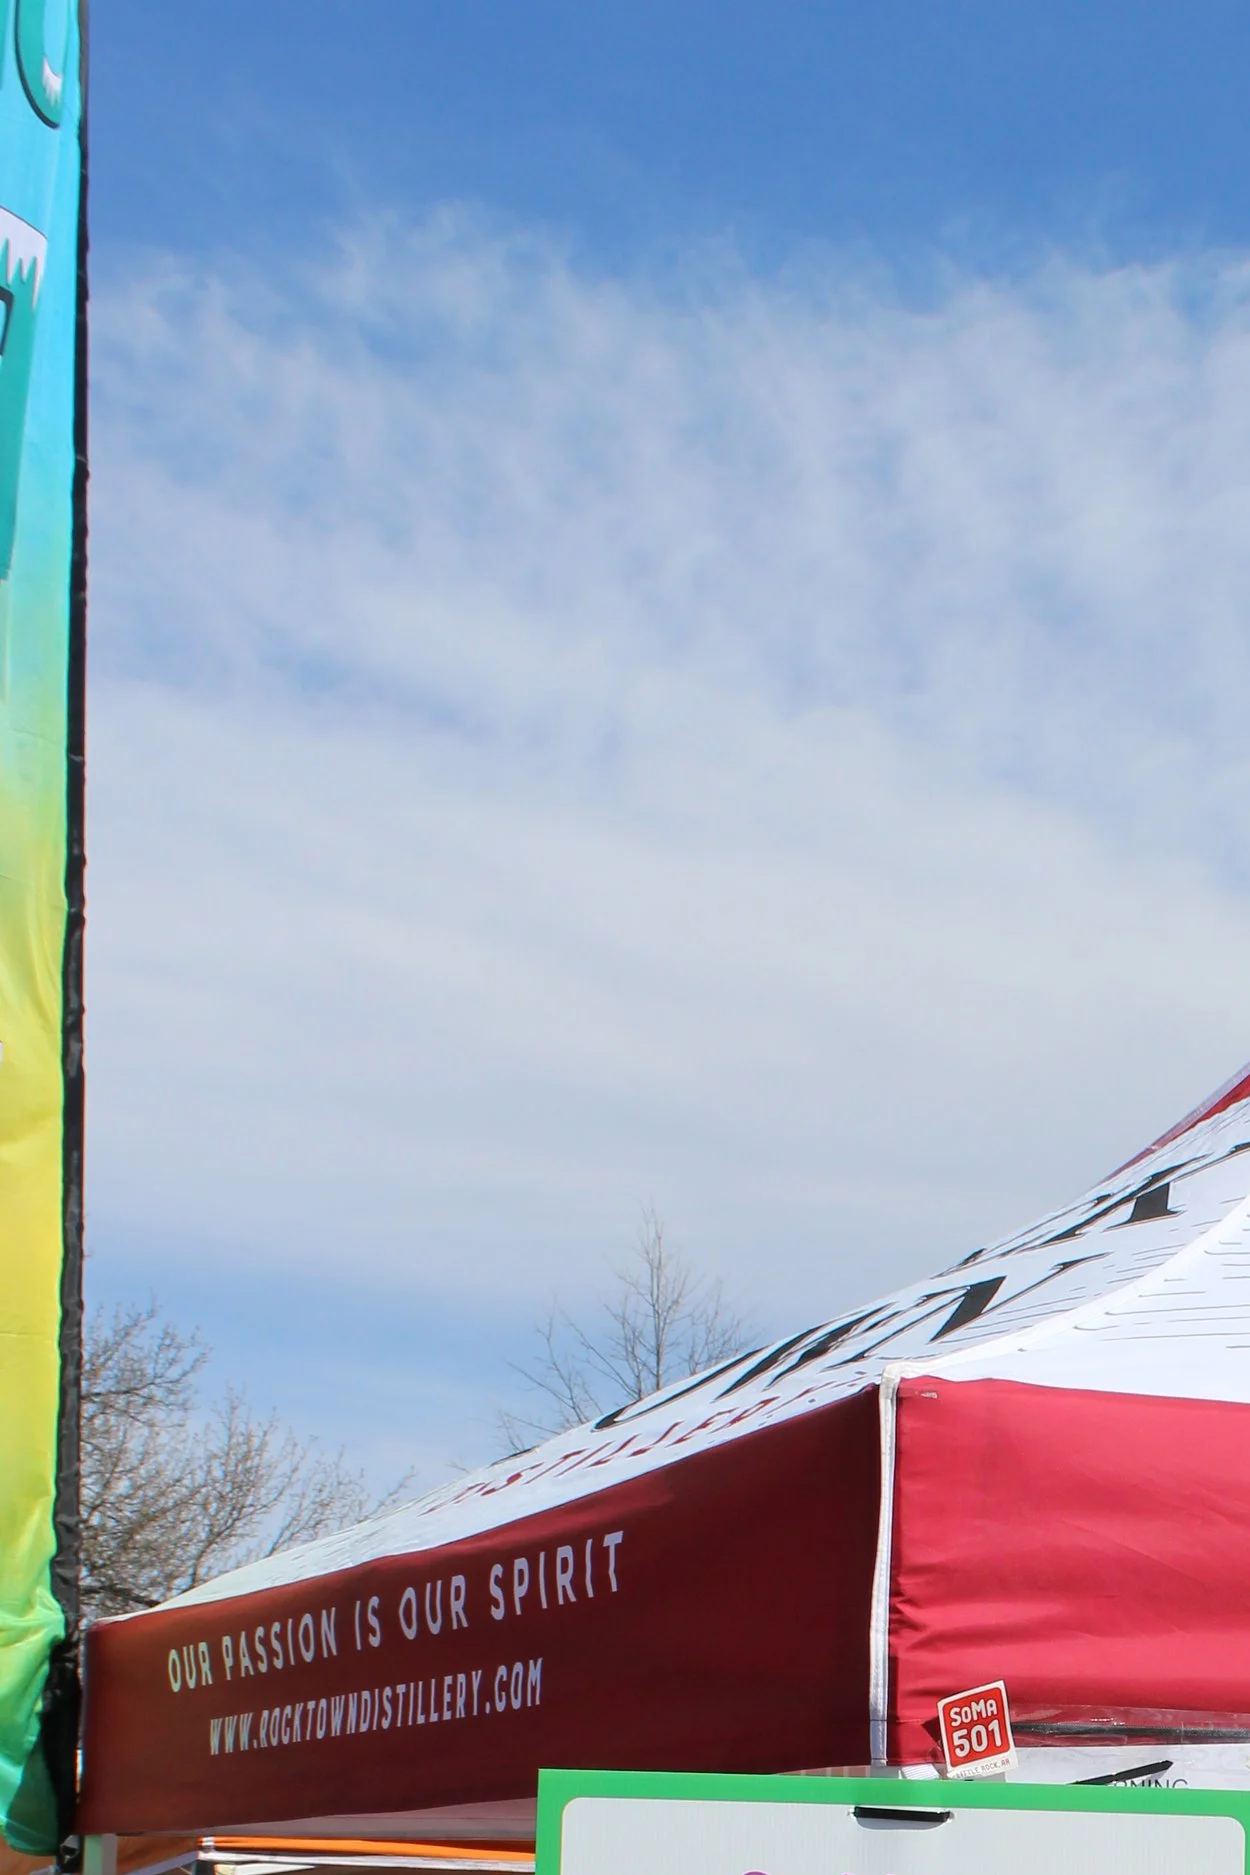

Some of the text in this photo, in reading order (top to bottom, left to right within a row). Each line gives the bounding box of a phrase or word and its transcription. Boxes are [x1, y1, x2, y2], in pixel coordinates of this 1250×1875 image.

[168, 1530, 624, 1693] OUR PASSION IS OUR SPIRIT
[209, 1657, 544, 1756] WWW.ROCKTOWNDISTILLERY.COM
[950, 1699, 998, 1727] SoMA
[952, 1719, 1002, 1758] 501
